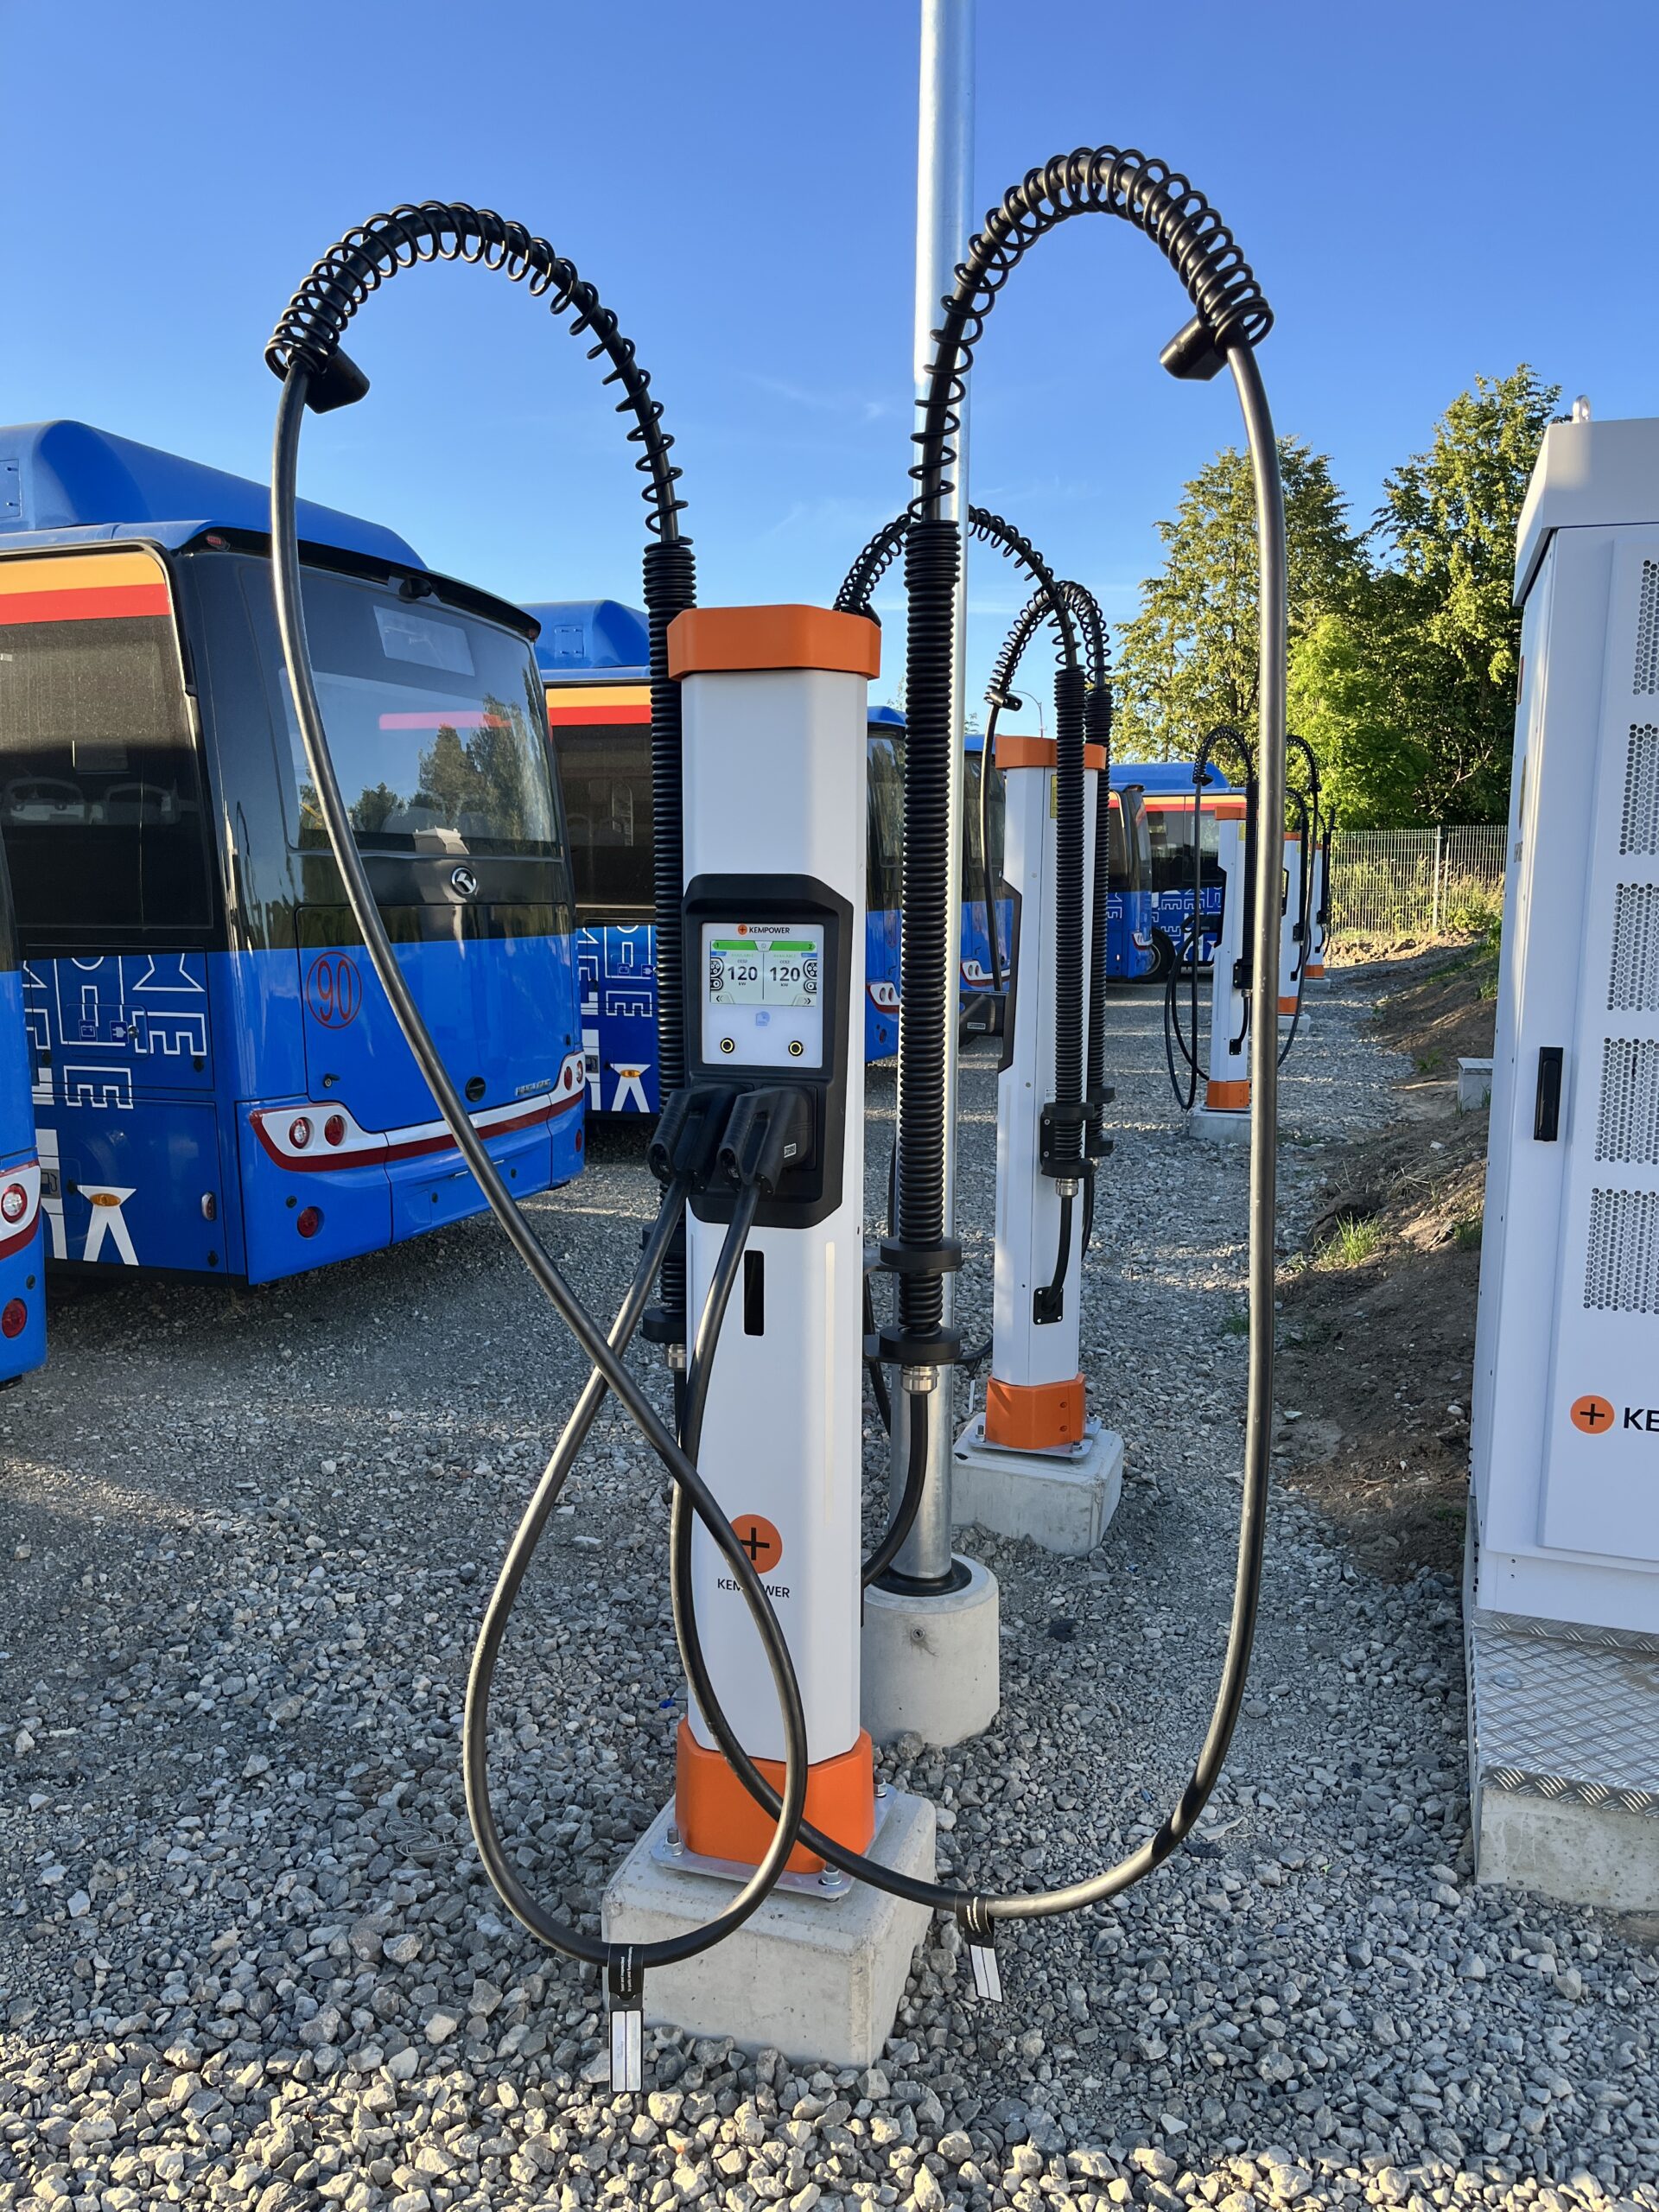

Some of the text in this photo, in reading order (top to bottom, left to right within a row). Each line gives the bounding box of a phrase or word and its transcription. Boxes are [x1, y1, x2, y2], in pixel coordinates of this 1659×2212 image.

[728, 966, 759, 981] 120
[770, 967, 801, 982] 120
[318, 960, 353, 1021] 90
[1623, 1408, 1659, 1432] KE
[717, 1578, 790, 1598] KEMWER
